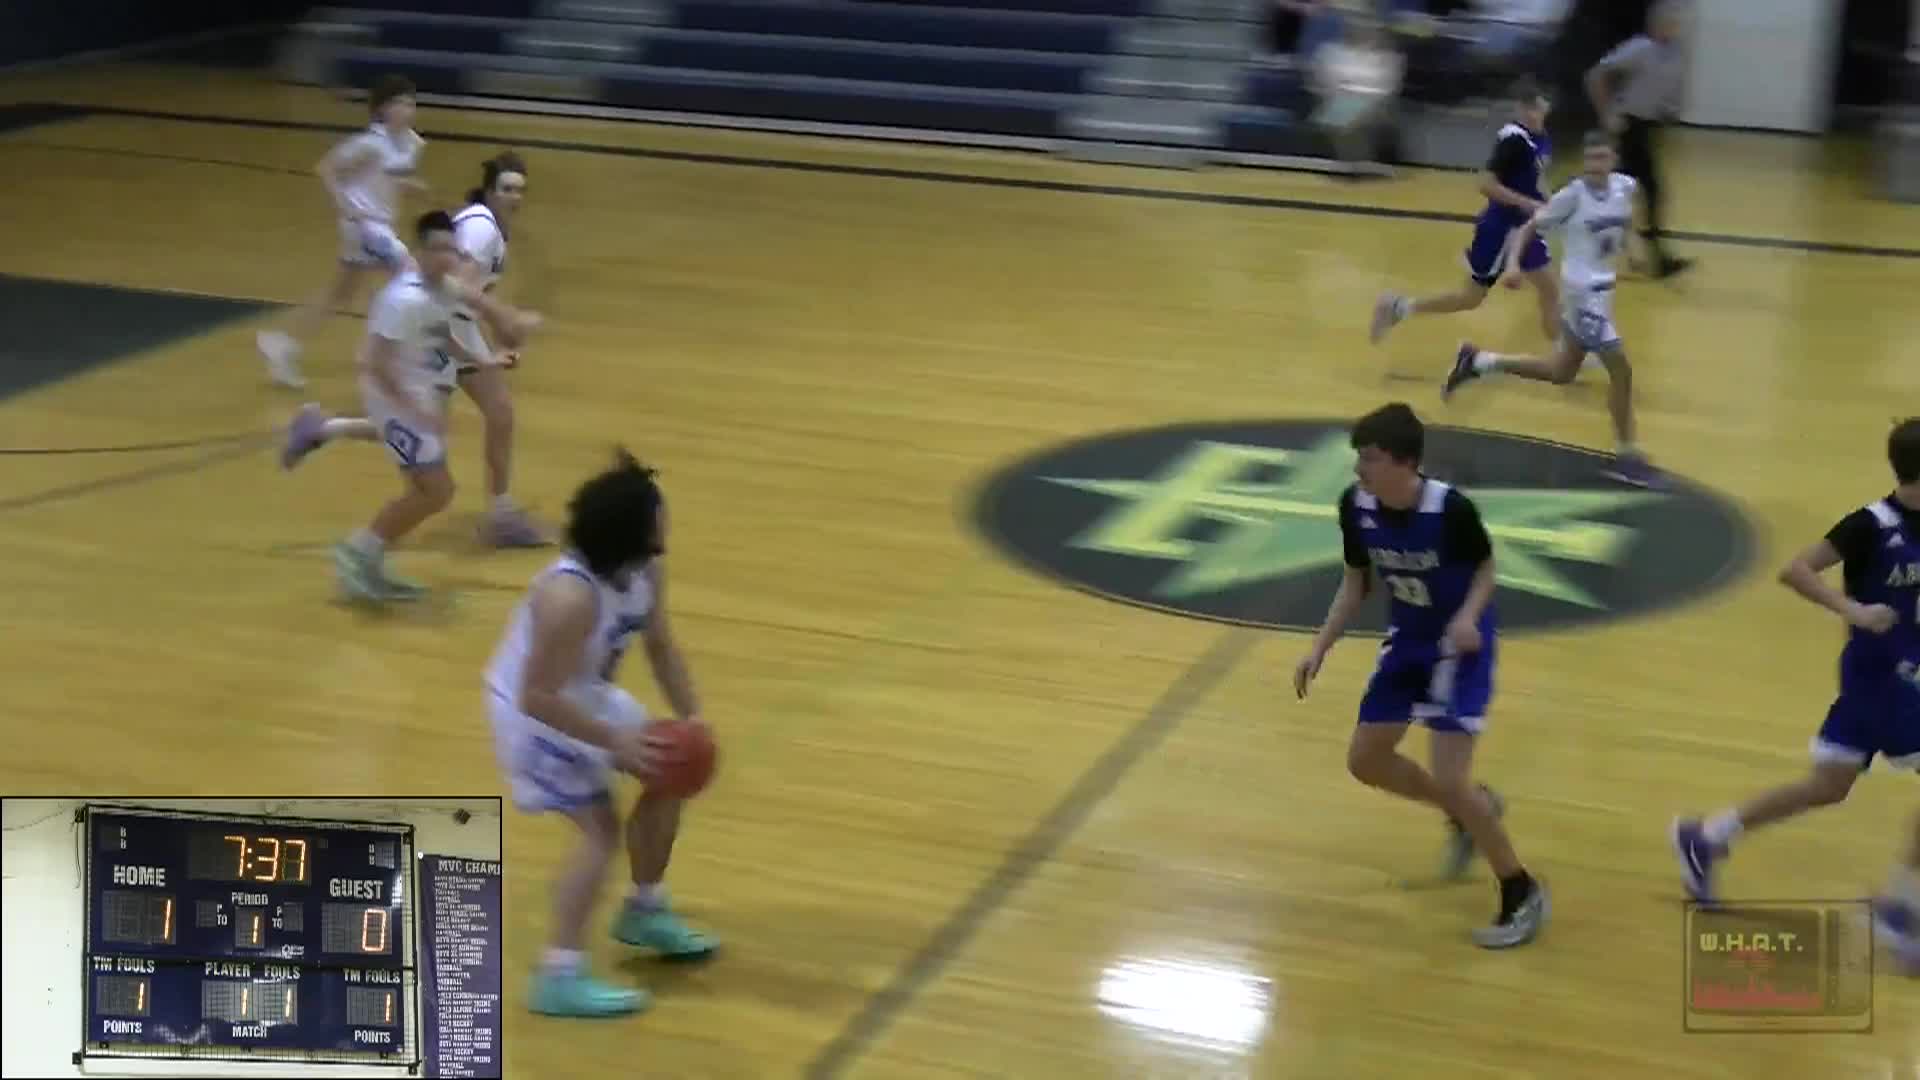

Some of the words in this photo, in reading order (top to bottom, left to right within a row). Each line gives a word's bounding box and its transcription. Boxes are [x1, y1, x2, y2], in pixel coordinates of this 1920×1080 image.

[224, 836, 306, 882] 7:37
[438, 860, 462, 872] MVC
[113, 864, 166, 887] HOME
[231, 892, 269, 906] PERIOD
[329, 878, 383, 899] GUEST
[164, 899, 171, 940] 1
[252, 916, 259, 943] 1
[362, 908, 386, 951] 0
[93, 956, 113, 971] TM
[117, 957, 155, 974] FOULS
[205, 961, 250, 977] PLAYER
[264, 965, 301, 979] FOULS
[343, 968, 361, 982] TM
[365, 969, 400, 984] FOULS
[138, 982, 145, 1011] 1
[241, 987, 248, 1017] 1
[285, 988, 291, 1018] 1
[384, 993, 391, 1022] 1
[103, 1020, 143, 1034] POINTS
[232, 1026, 268, 1038] MATCH
[354, 1030, 391, 1044] POINTS
